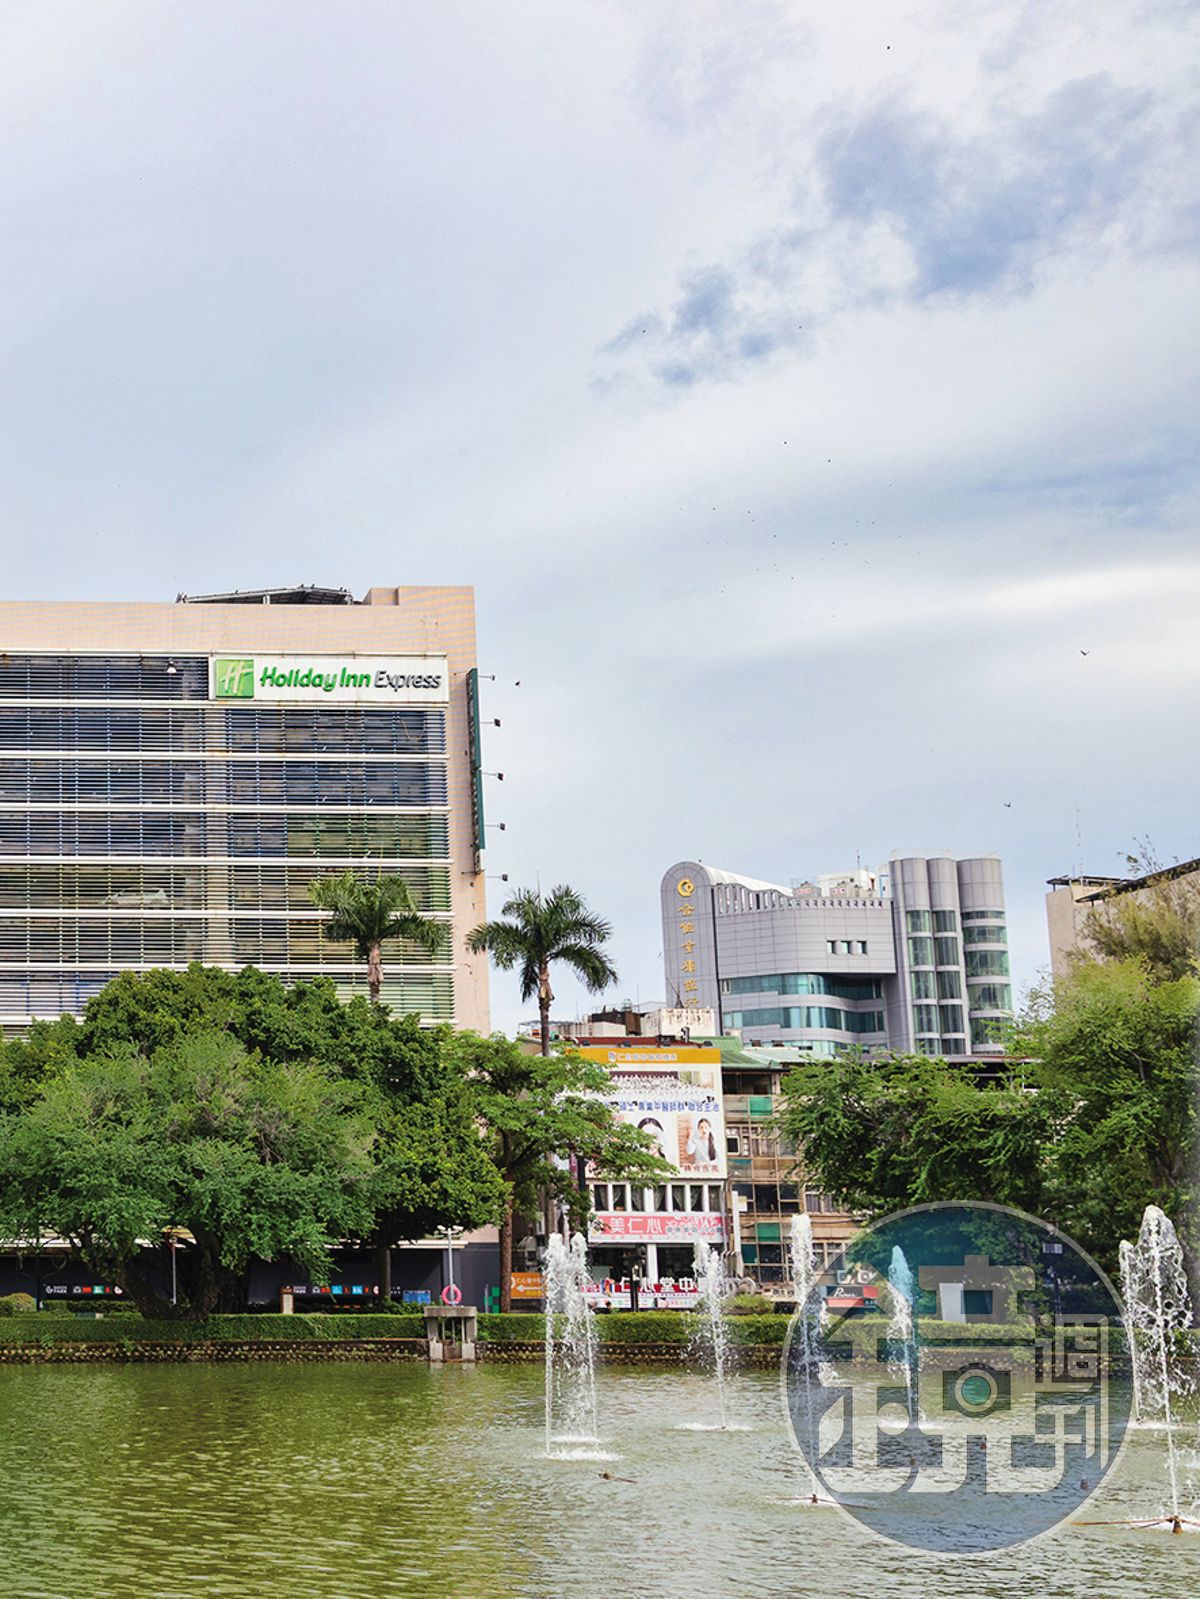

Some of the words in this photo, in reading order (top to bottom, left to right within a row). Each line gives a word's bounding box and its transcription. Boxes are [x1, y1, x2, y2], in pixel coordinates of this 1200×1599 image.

[260, 666, 337, 692] Holiday
[340, 667, 371, 688] Inn
[374, 670, 442, 691] Express
[620, 1276, 701, 1293] 仁心堂中
